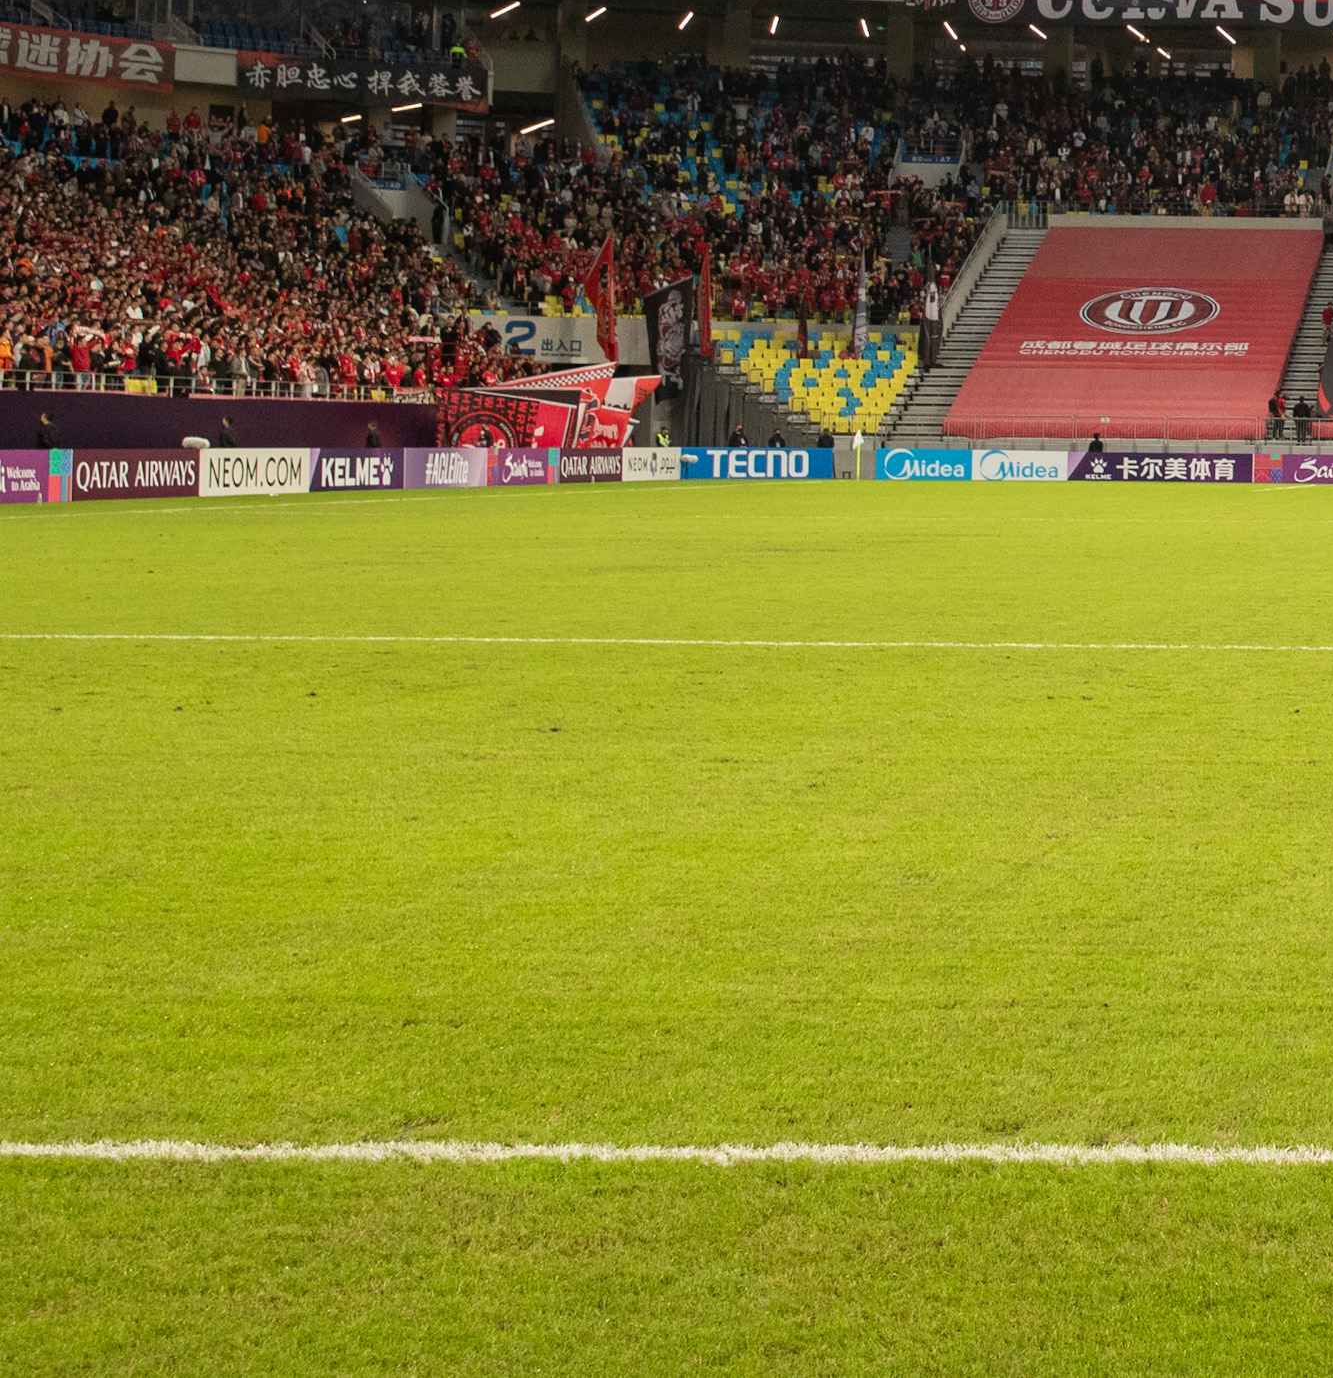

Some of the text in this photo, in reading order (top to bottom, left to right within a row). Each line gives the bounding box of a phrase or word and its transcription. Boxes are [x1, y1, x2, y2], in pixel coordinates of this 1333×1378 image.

[245, 59, 359, 90] 赤胆忠心
[1120, 290, 1193, 300] CHENGDU
[505, 320, 536, 356] 2
[541, 338, 582, 353] 出入口
[1108, 349, 1220, 357] RONGCHENG
[7, 467, 36, 480] Welcome
[208, 457, 302, 489] NEOM.COM
[321, 458, 380, 487] KELME
[560, 455, 622, 477] QATAR AIRWAYS
[628, 457, 648, 471] NEOM
[706, 450, 810, 479] TECNO
[897, 458, 965, 479] Midea
[992, 460, 1059, 479] Midea
[1116, 457, 1236, 481] 卡尔美体育
[19, 479, 41, 492] Arabia
[76, 460, 196, 492] QATAR AIRWAYS
